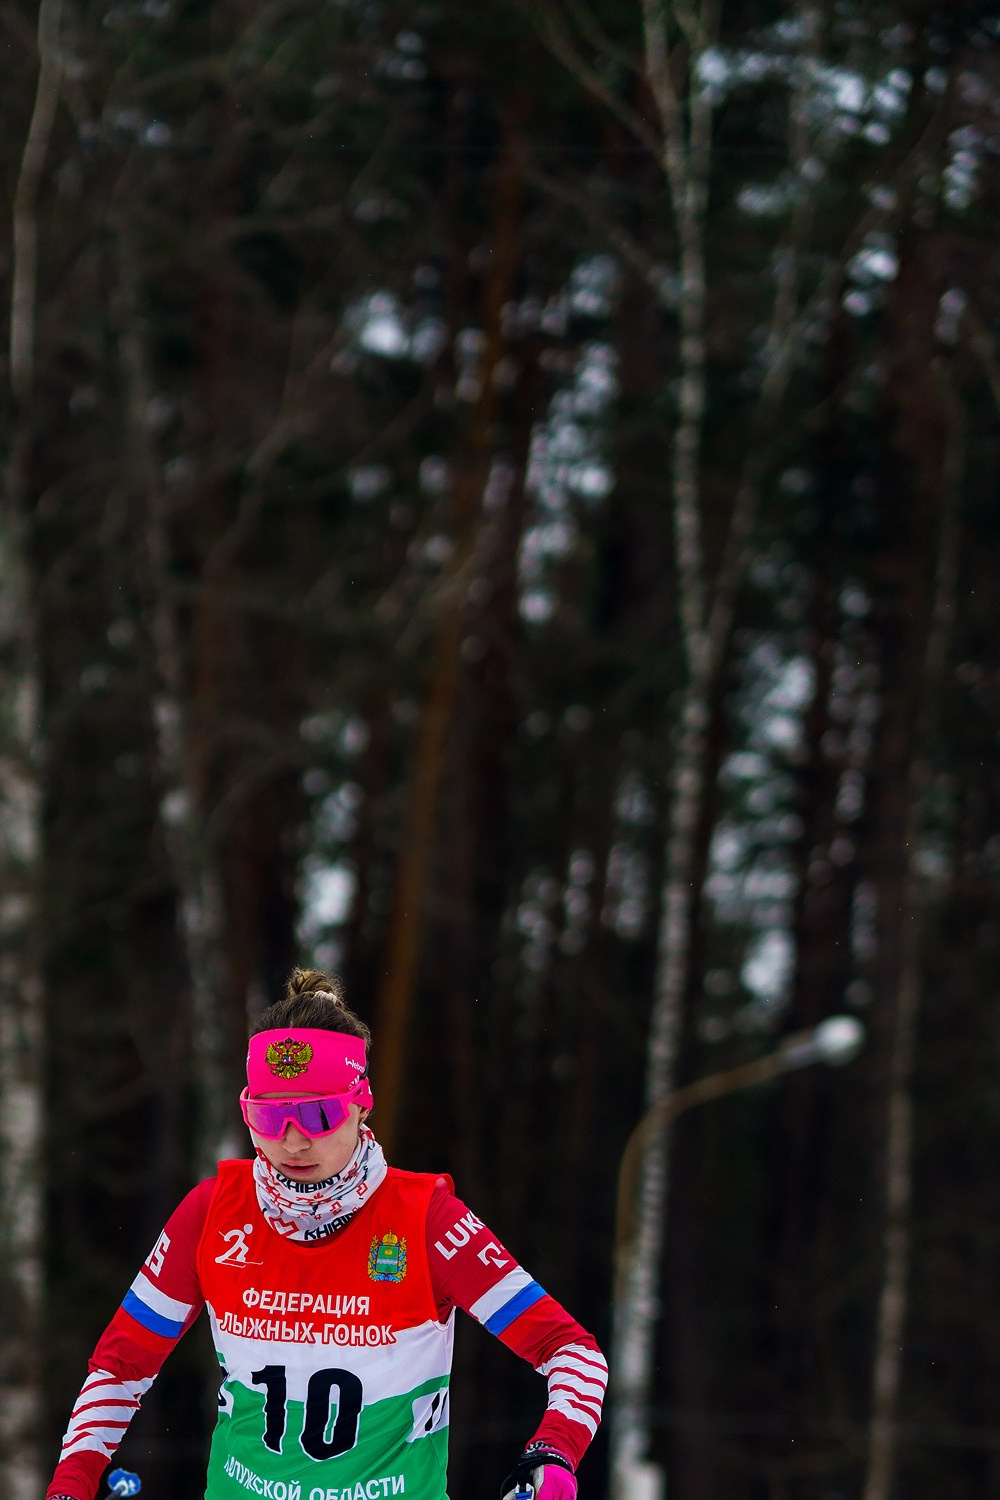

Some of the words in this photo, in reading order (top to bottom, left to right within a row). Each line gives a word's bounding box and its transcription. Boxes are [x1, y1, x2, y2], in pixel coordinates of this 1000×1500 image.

[242, 1287, 370, 1319] ФЕДЕРАЦИЯ
[220, 1311, 315, 1344] ЛЫЖНЫХ
[322, 1322, 397, 1347] ГОНОК
[249, 1364, 364, 1461] 10
